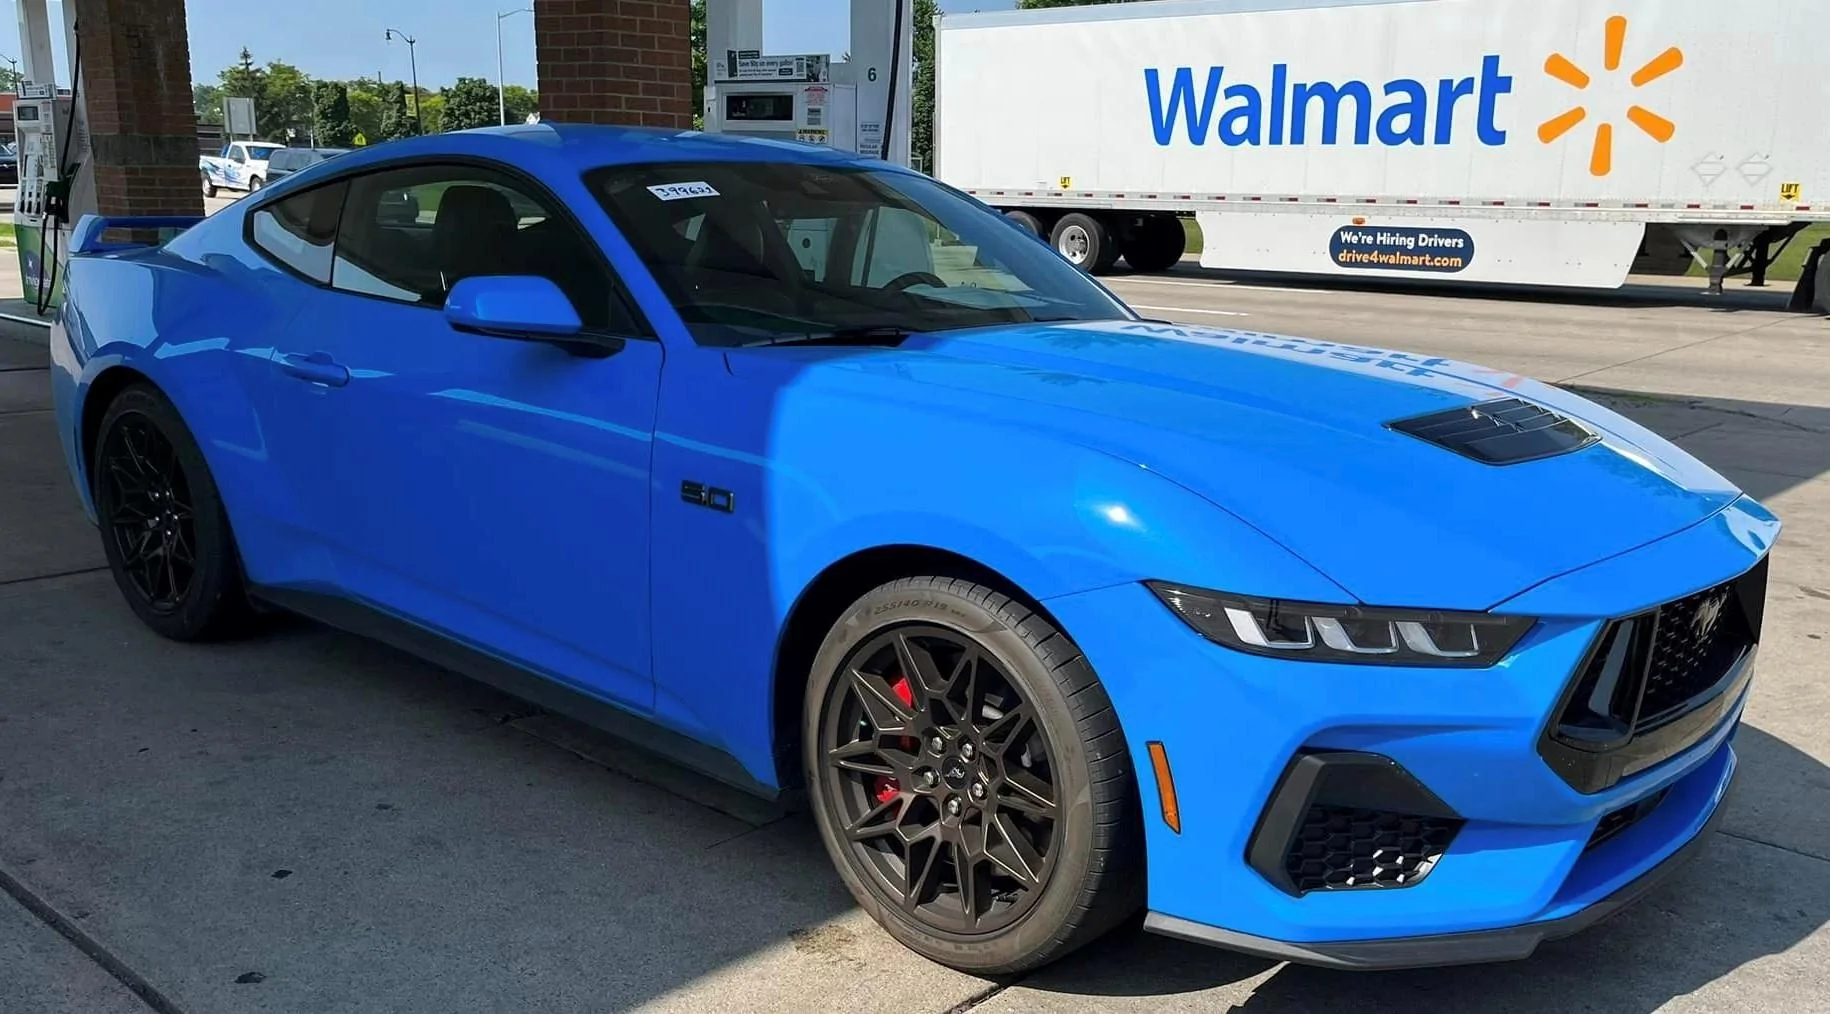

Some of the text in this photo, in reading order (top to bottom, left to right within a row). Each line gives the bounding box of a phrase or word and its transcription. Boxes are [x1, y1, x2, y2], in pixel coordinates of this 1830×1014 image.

[867, 67, 877, 82] 6
[1144, 55, 1512, 146] Walmart
[1781, 183, 1799, 193] LIFT
[1340, 231, 1464, 249] We're Hiring Drivers
[1338, 250, 1462, 267] drive4walmart.com
